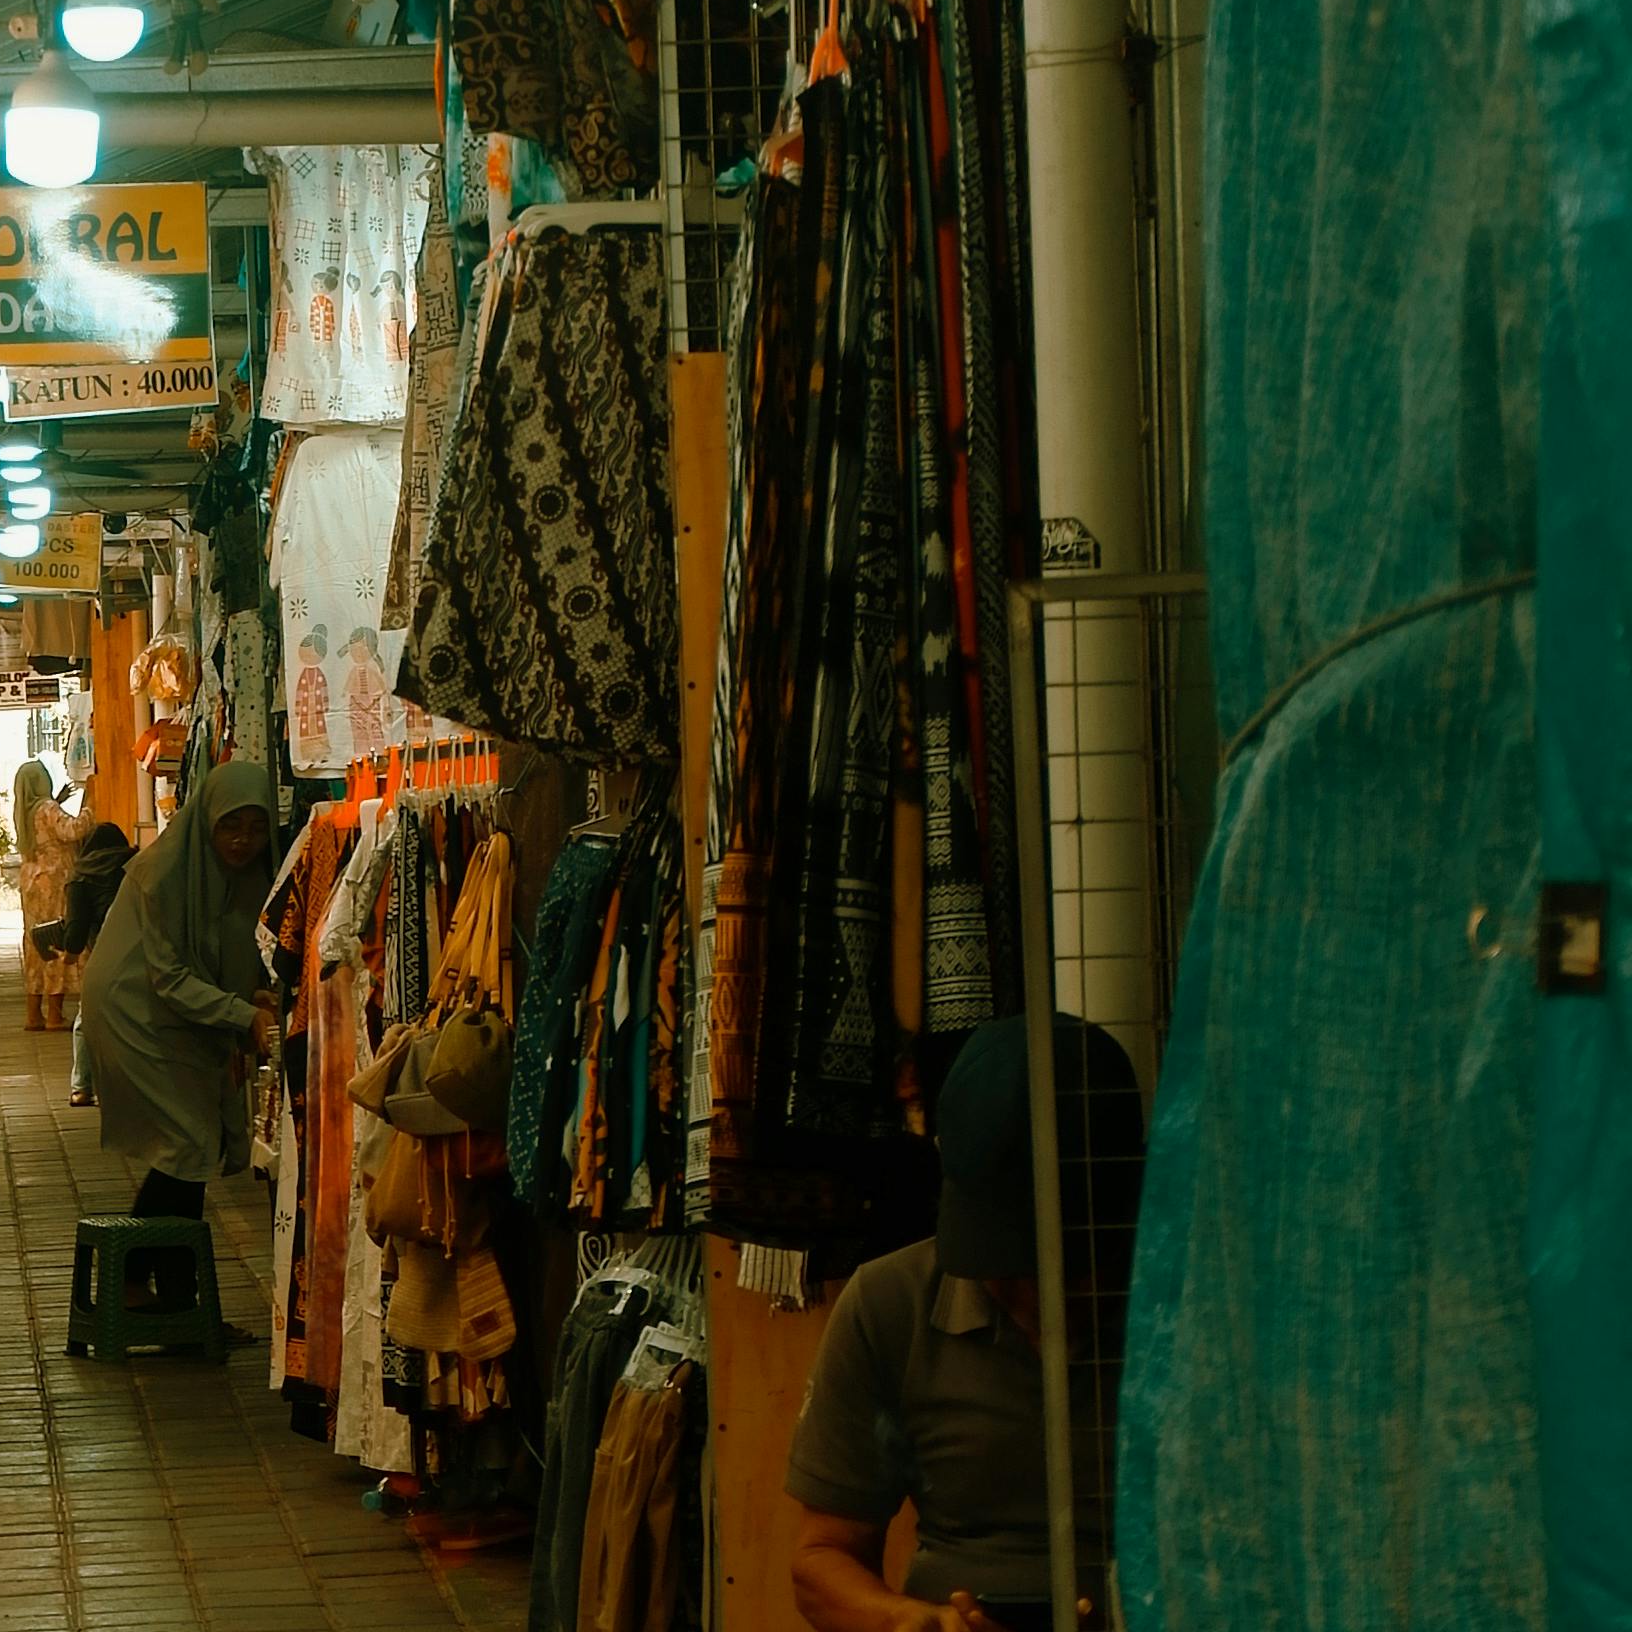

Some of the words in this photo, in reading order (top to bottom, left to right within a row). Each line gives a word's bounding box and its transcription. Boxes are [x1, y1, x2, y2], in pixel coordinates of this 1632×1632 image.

[11, 374, 112, 405] KATUN
[137, 366, 213, 394] 40.000
[13, 562, 79, 578] 100.000
